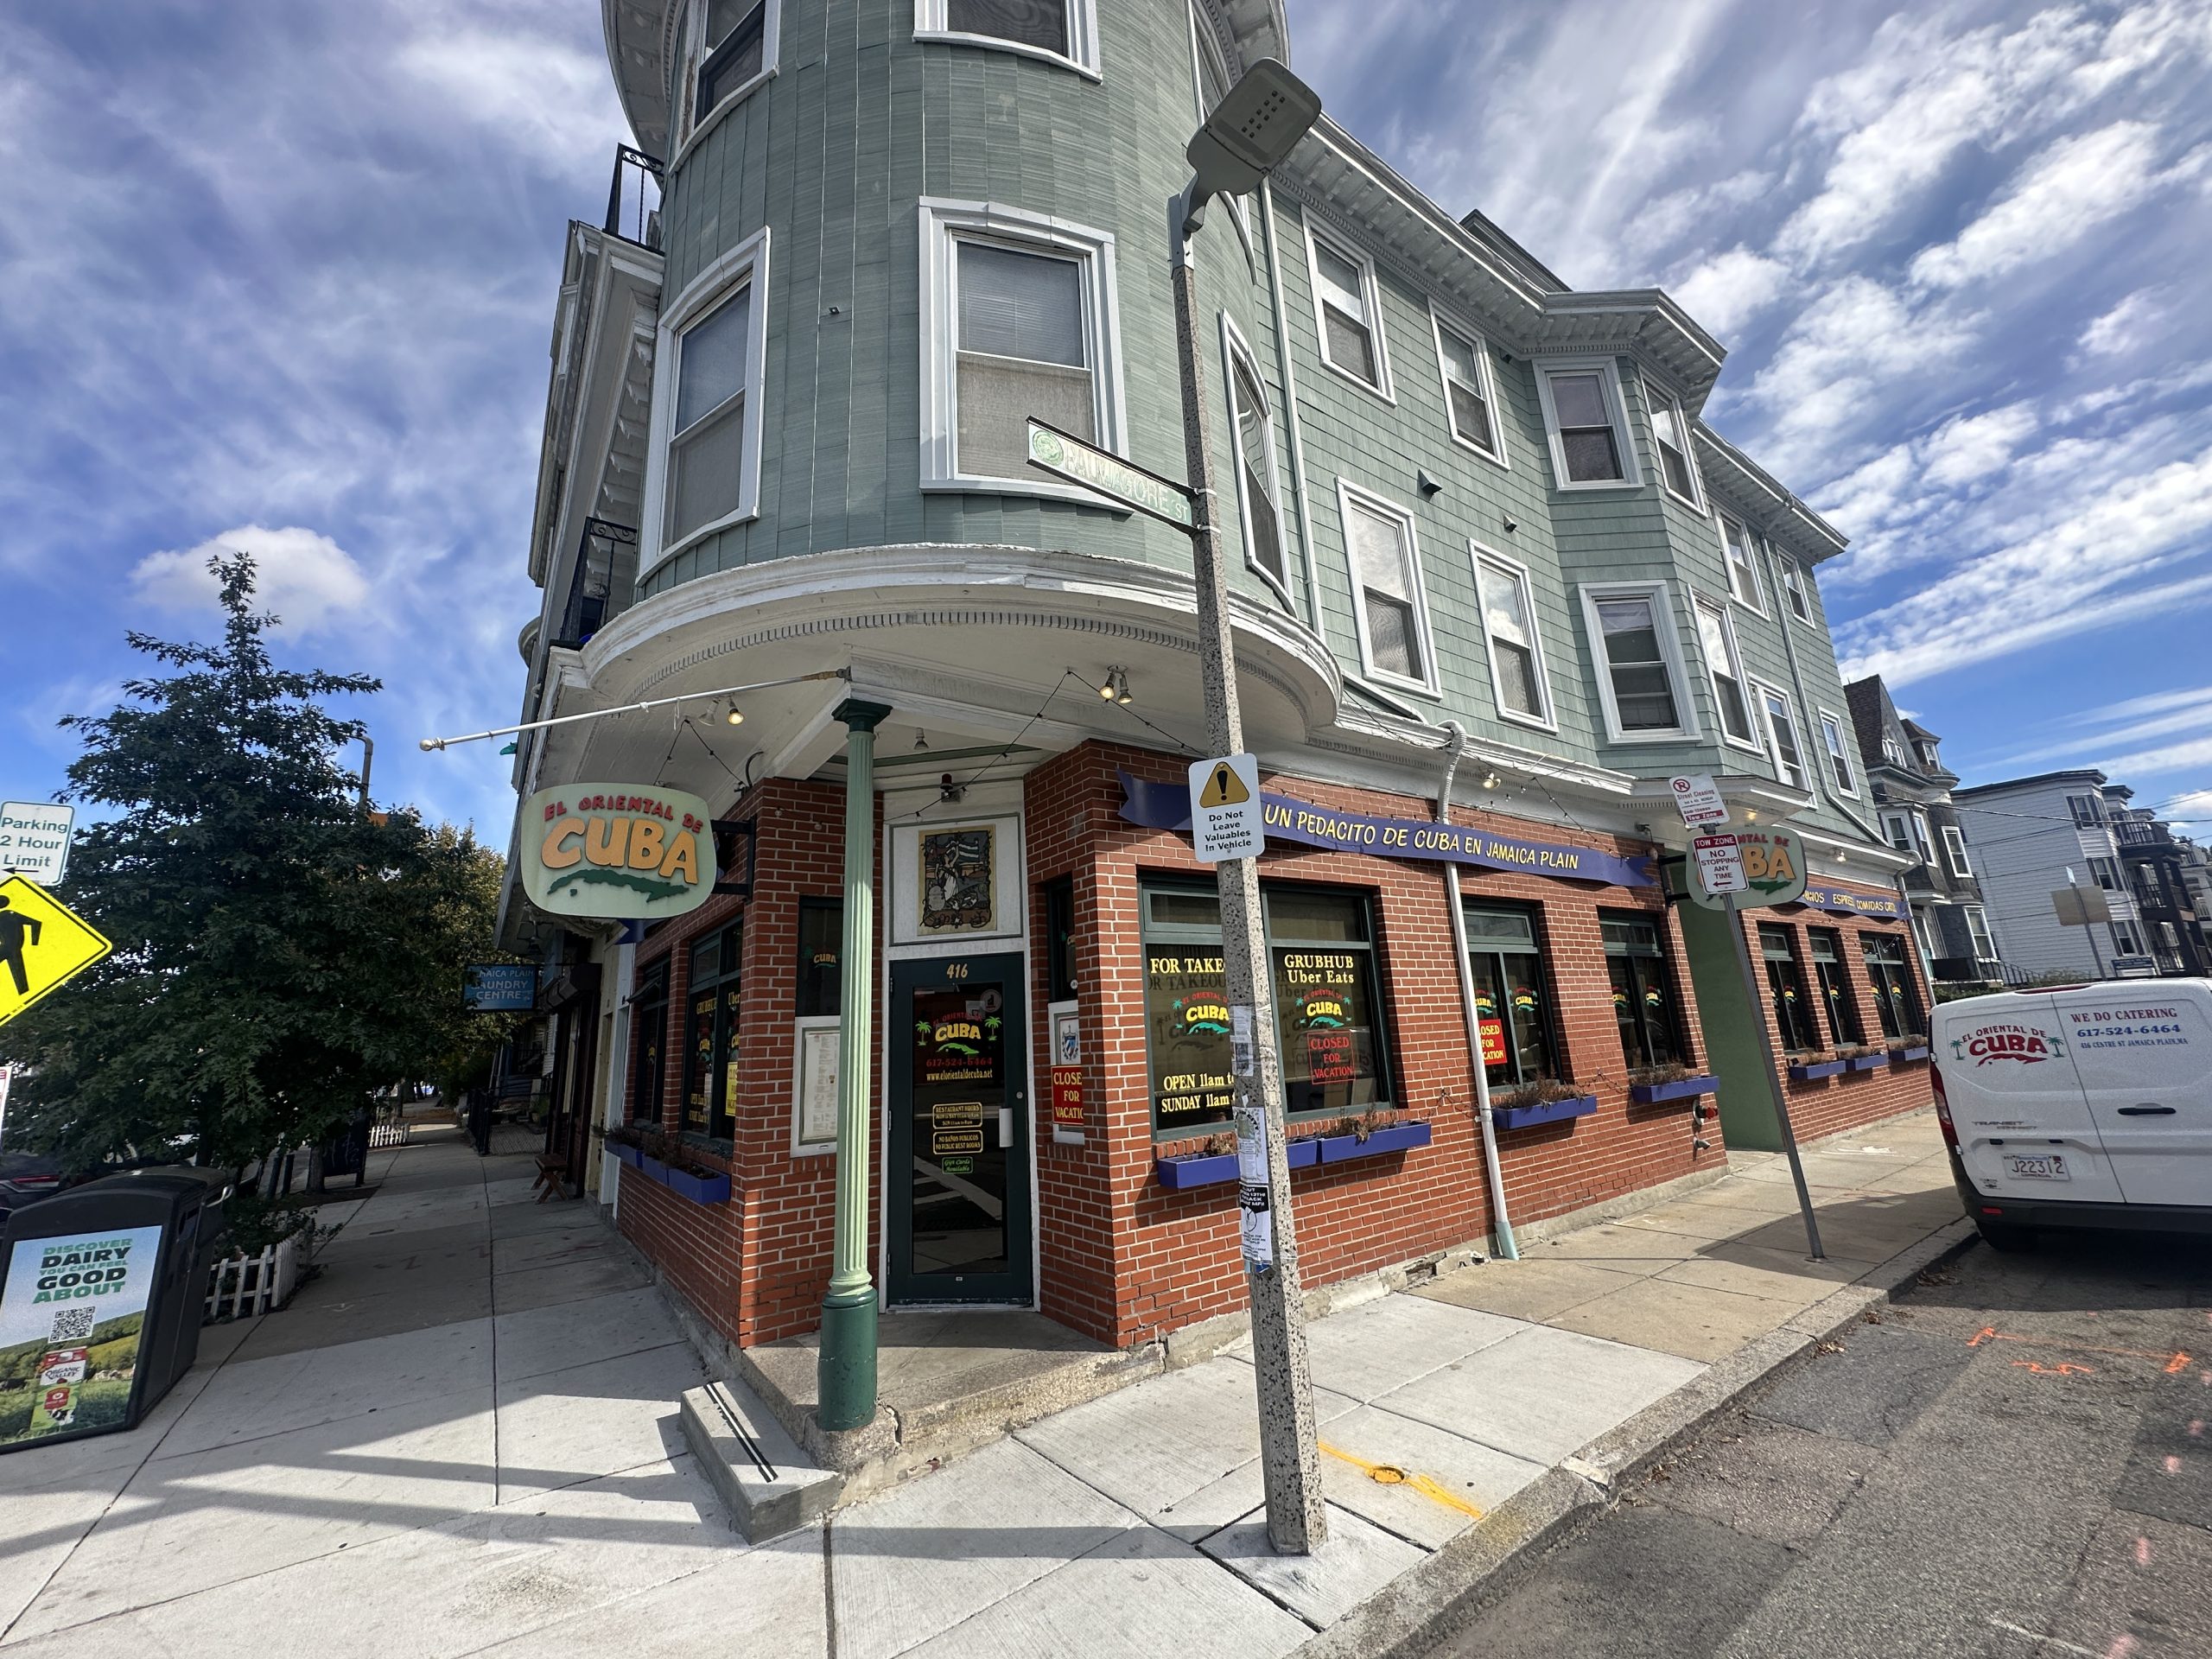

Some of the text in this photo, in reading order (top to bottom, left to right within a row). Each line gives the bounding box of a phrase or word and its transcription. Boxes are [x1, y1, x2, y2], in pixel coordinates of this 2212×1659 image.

[1174, 503, 1188, 520] ST
[544, 795, 703, 833] EL ORIENTAL DE
[1225, 810, 1243, 819] Not
[1, 817, 68, 834] Parking
[1213, 822, 1241, 831] Leave
[0, 836, 62, 849] 2 Hour
[1205, 830, 1251, 842] Valuables
[1264, 804, 1579, 869] UN PEDACITO DE CUBA EN JAMAICA PLAIN
[1713, 836, 1735, 845] ZONE
[1774, 836, 1789, 847] DE
[541, 816, 698, 885] CUBA
[1217, 839, 1252, 850] Vehicle
[3, 854, 51, 867] Limit
[1709, 849, 1726, 858] NO
[1700, 856, 1739, 866] STOPPING
[1742, 845, 1796, 880] BA
[813, 953, 836, 963] CUBA
[1284, 954, 1354, 969] GRUBHUB
[946, 963, 968, 979] 416
[1150, 957, 1225, 974] FOR TAKE
[1287, 969, 1354, 983] Uber Eats
[476, 991, 522, 1000] CENTRE
[1516, 995, 1533, 1005] CUBA
[1185, 1005, 1229, 1021] CUBA
[1306, 1001, 1342, 1016] CUBA
[2070, 1007, 2177, 1022] WE DO CATERING
[935, 1023, 981, 1041] CUBA
[1480, 1025, 1500, 1036] OSED
[1961, 1025, 2047, 1043] EL ORIENTAL DE
[2077, 1024, 2181, 1037] 617-524-6464
[1311, 1037, 1349, 1050] CLOSED
[1969, 1034, 2048, 1056] CUBA
[2127, 1039, 2156, 1047] JAMAICA
[1323, 1052, 1340, 1064] FOR
[1483, 1050, 1503, 1060] CATION
[1053, 1071, 1083, 1085] CLOSE
[1314, 1066, 1352, 1078] VACATION
[1163, 1074, 1196, 1090] OPEN
[1199, 1072, 1224, 1087] 11am
[1064, 1090, 1079, 1102] FOR
[1161, 1095, 1201, 1113] SUNDAY
[1205, 1093, 1230, 1107] 11am
[2012, 1160, 2065, 1174] J22312
[43, 1238, 133, 1255] DISCOVER
[41, 1246, 132, 1268] DAIRY
[40, 1260, 129, 1275] YOU CAN FEEL
[37, 1268, 127, 1290] GOOD
[32, 1281, 126, 1304] ABOUT
